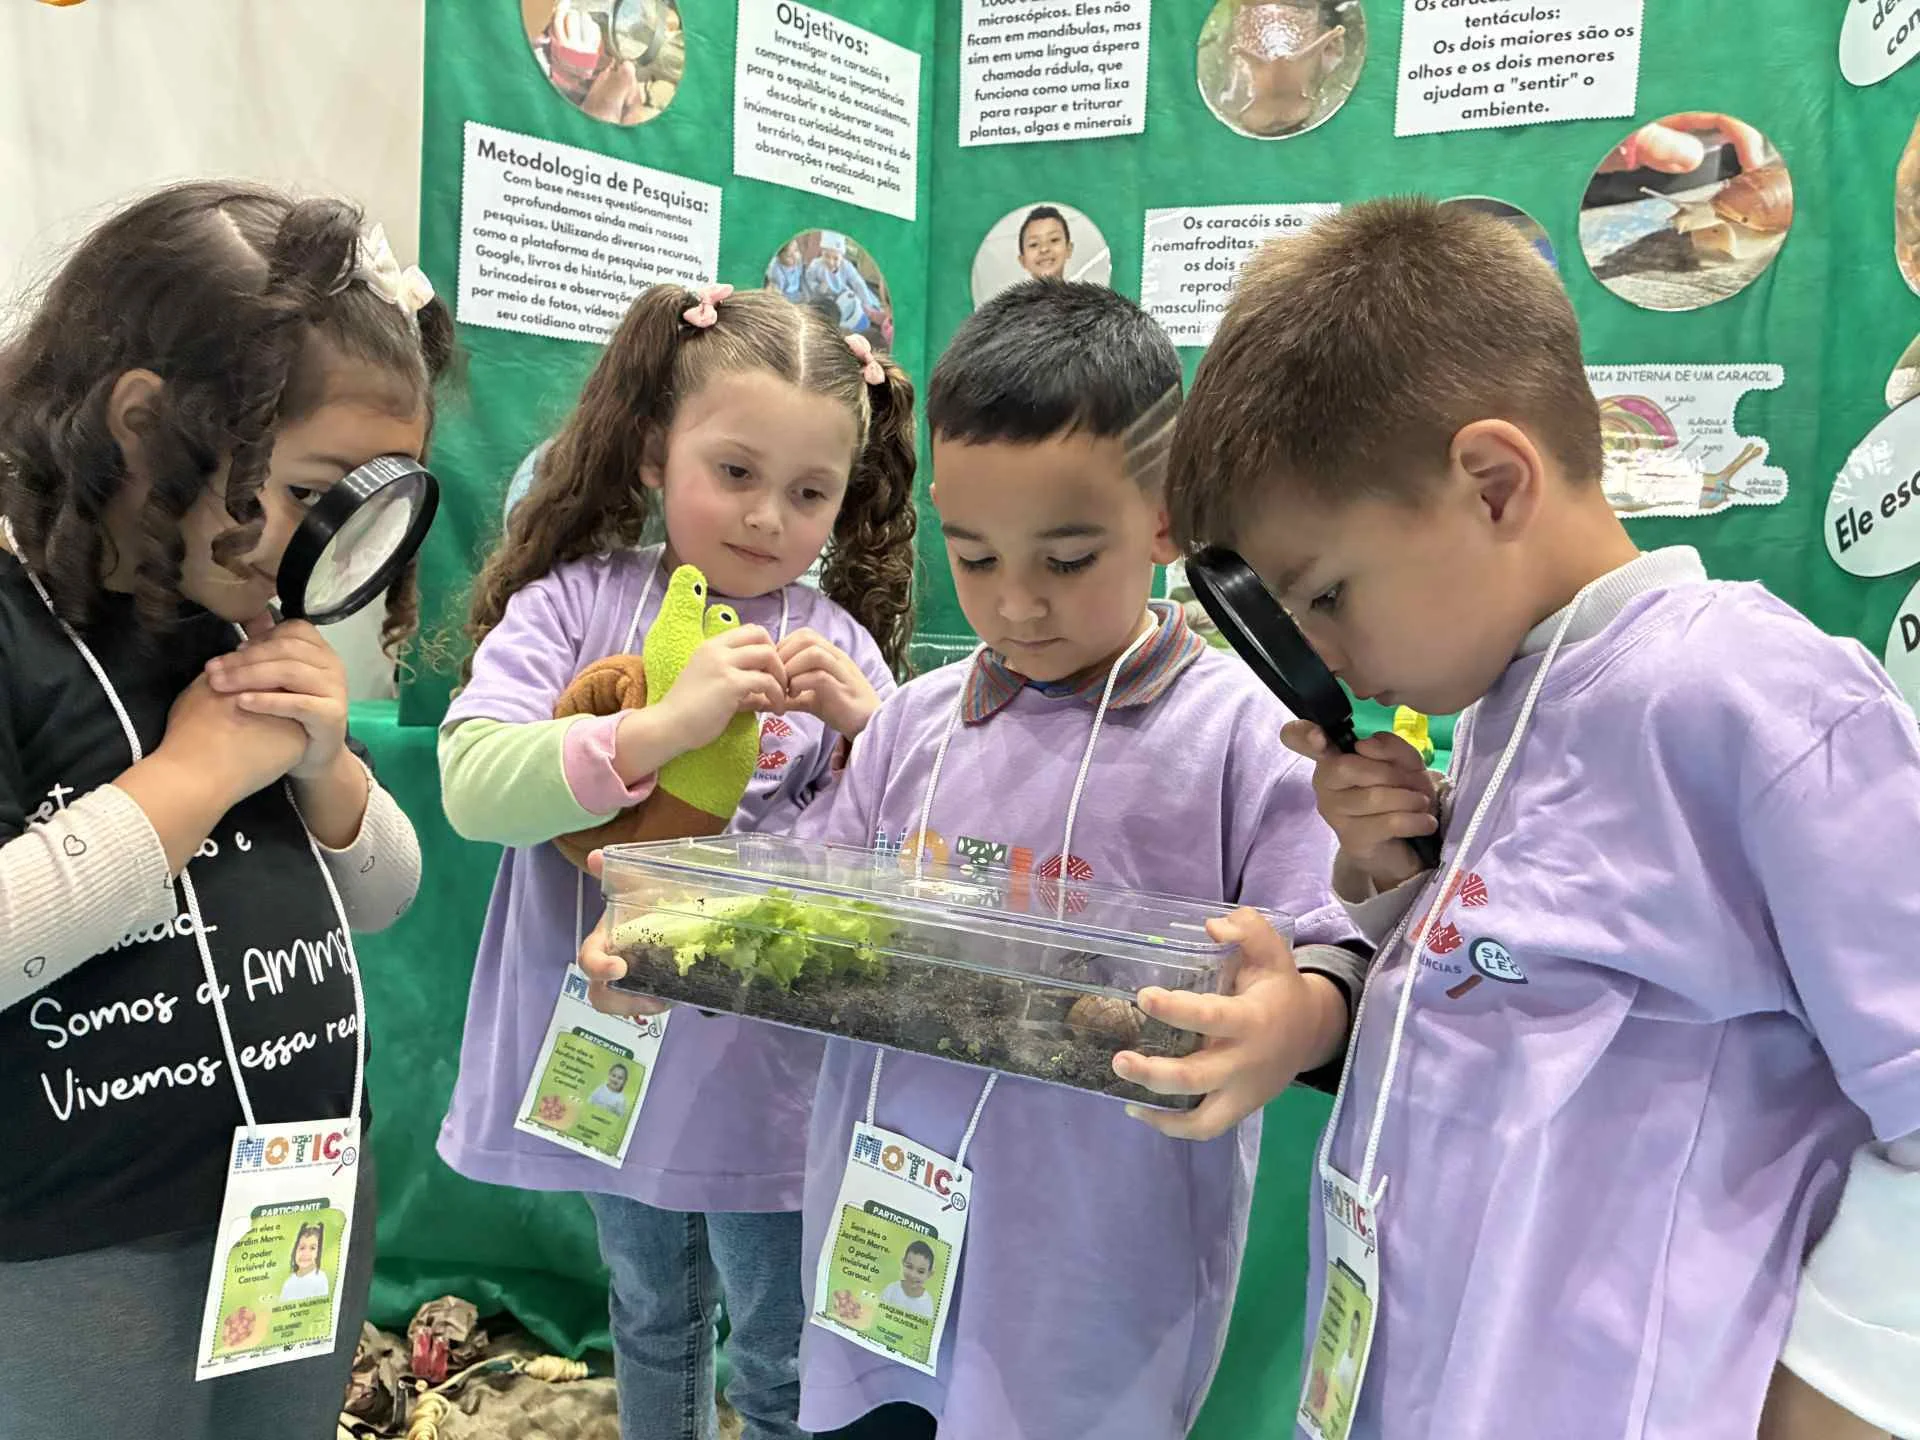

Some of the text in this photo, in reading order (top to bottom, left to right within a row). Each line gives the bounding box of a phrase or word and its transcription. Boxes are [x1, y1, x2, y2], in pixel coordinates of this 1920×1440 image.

[777, 3, 868, 56] Objetivos:
[978, 1, 1130, 27] microscópicos. Eles não
[1465, 6, 1560, 28] tentáculos:
[775, 29, 827, 58] Investigar
[830, 54, 841, 64] os
[968, 21, 1142, 46] ficam em mandíbulas, mas
[1433, 25, 1634, 54] Os dois maiores são os
[755, 47, 827, 76] compreender
[830, 72, 847, 84] sua
[968, 40, 1140, 65] sim em uma língua áspera
[1408, 51, 1614, 80] olhos e os dois menores
[747, 63, 774, 79] para
[777, 73, 784, 81] o
[787, 75, 837, 99] equilíbrio
[839, 91, 852, 104] do
[982, 60, 1123, 82] chamada rádula, que
[975, 77, 1129, 102] funciona como uma lixa
[1423, 72, 1594, 104] ajudam a "sentir" o
[766, 85, 894, 137] descobrir e observar suas
[980, 98, 1123, 122] para raspar e triturar
[1462, 101, 1550, 120] ambiente.
[744, 96, 911, 160] inúmeras curiosidades através do
[970, 114, 1132, 141] plantas, algas e minerais
[757, 121, 805, 146] terrário,
[807, 135, 826, 150] das
[828, 144, 874, 167] pesquisas
[884, 159, 900, 175] das
[478, 138, 709, 213] Metodologia de Pesquisa:
[755, 139, 901, 192] observações realizadas pelas
[503, 170, 692, 226] Com base nesses questionamentos
[810, 174, 854, 195] crianças.
[504, 193, 689, 243] aprofundamos ainda mais nossos
[1183, 214, 1303, 230] Os caracóis são
[483, 209, 702, 265] pesquisas. Utilizando diversos recursos,
[473, 227, 507, 241] como
[510, 234, 518, 243] a
[521, 235, 589, 257] plataforma
[591, 248, 605, 261] de
[608, 253, 654, 272] pesquisa
[656, 265, 674, 278] por
[696, 272, 709, 283] do
[475, 244, 524, 266] Google,
[528, 253, 561, 271] livros
[564, 262, 578, 274] de
[581, 263, 626, 285] história,
[1184, 257, 1235, 271] os dois
[479, 264, 633, 303] brincadeiras e observaçõe
[1180, 276, 1233, 296] reprod
[471, 285, 494, 298] por
[497, 290, 528, 303] meio
[531, 293, 546, 306] de
[549, 298, 581, 314] fotos,
[497, 309, 614, 336] seu cotidiano atrav
[1616, 370, 1773, 382] INTERNA DE UM CARACOL
[1835, 506, 1874, 553] Ele
[31, 992, 178, 1049] Somos
[41, 1031, 317, 1121] Vivemos essa
[234, 1132, 342, 1169] MOTIC
[854, 1133, 953, 1196] MOTIC
[261, 1203, 321, 1217] PARTICIPANTE
[873, 1206, 930, 1236] PARTICIPANTE
[848, 1246, 855, 1254] O
